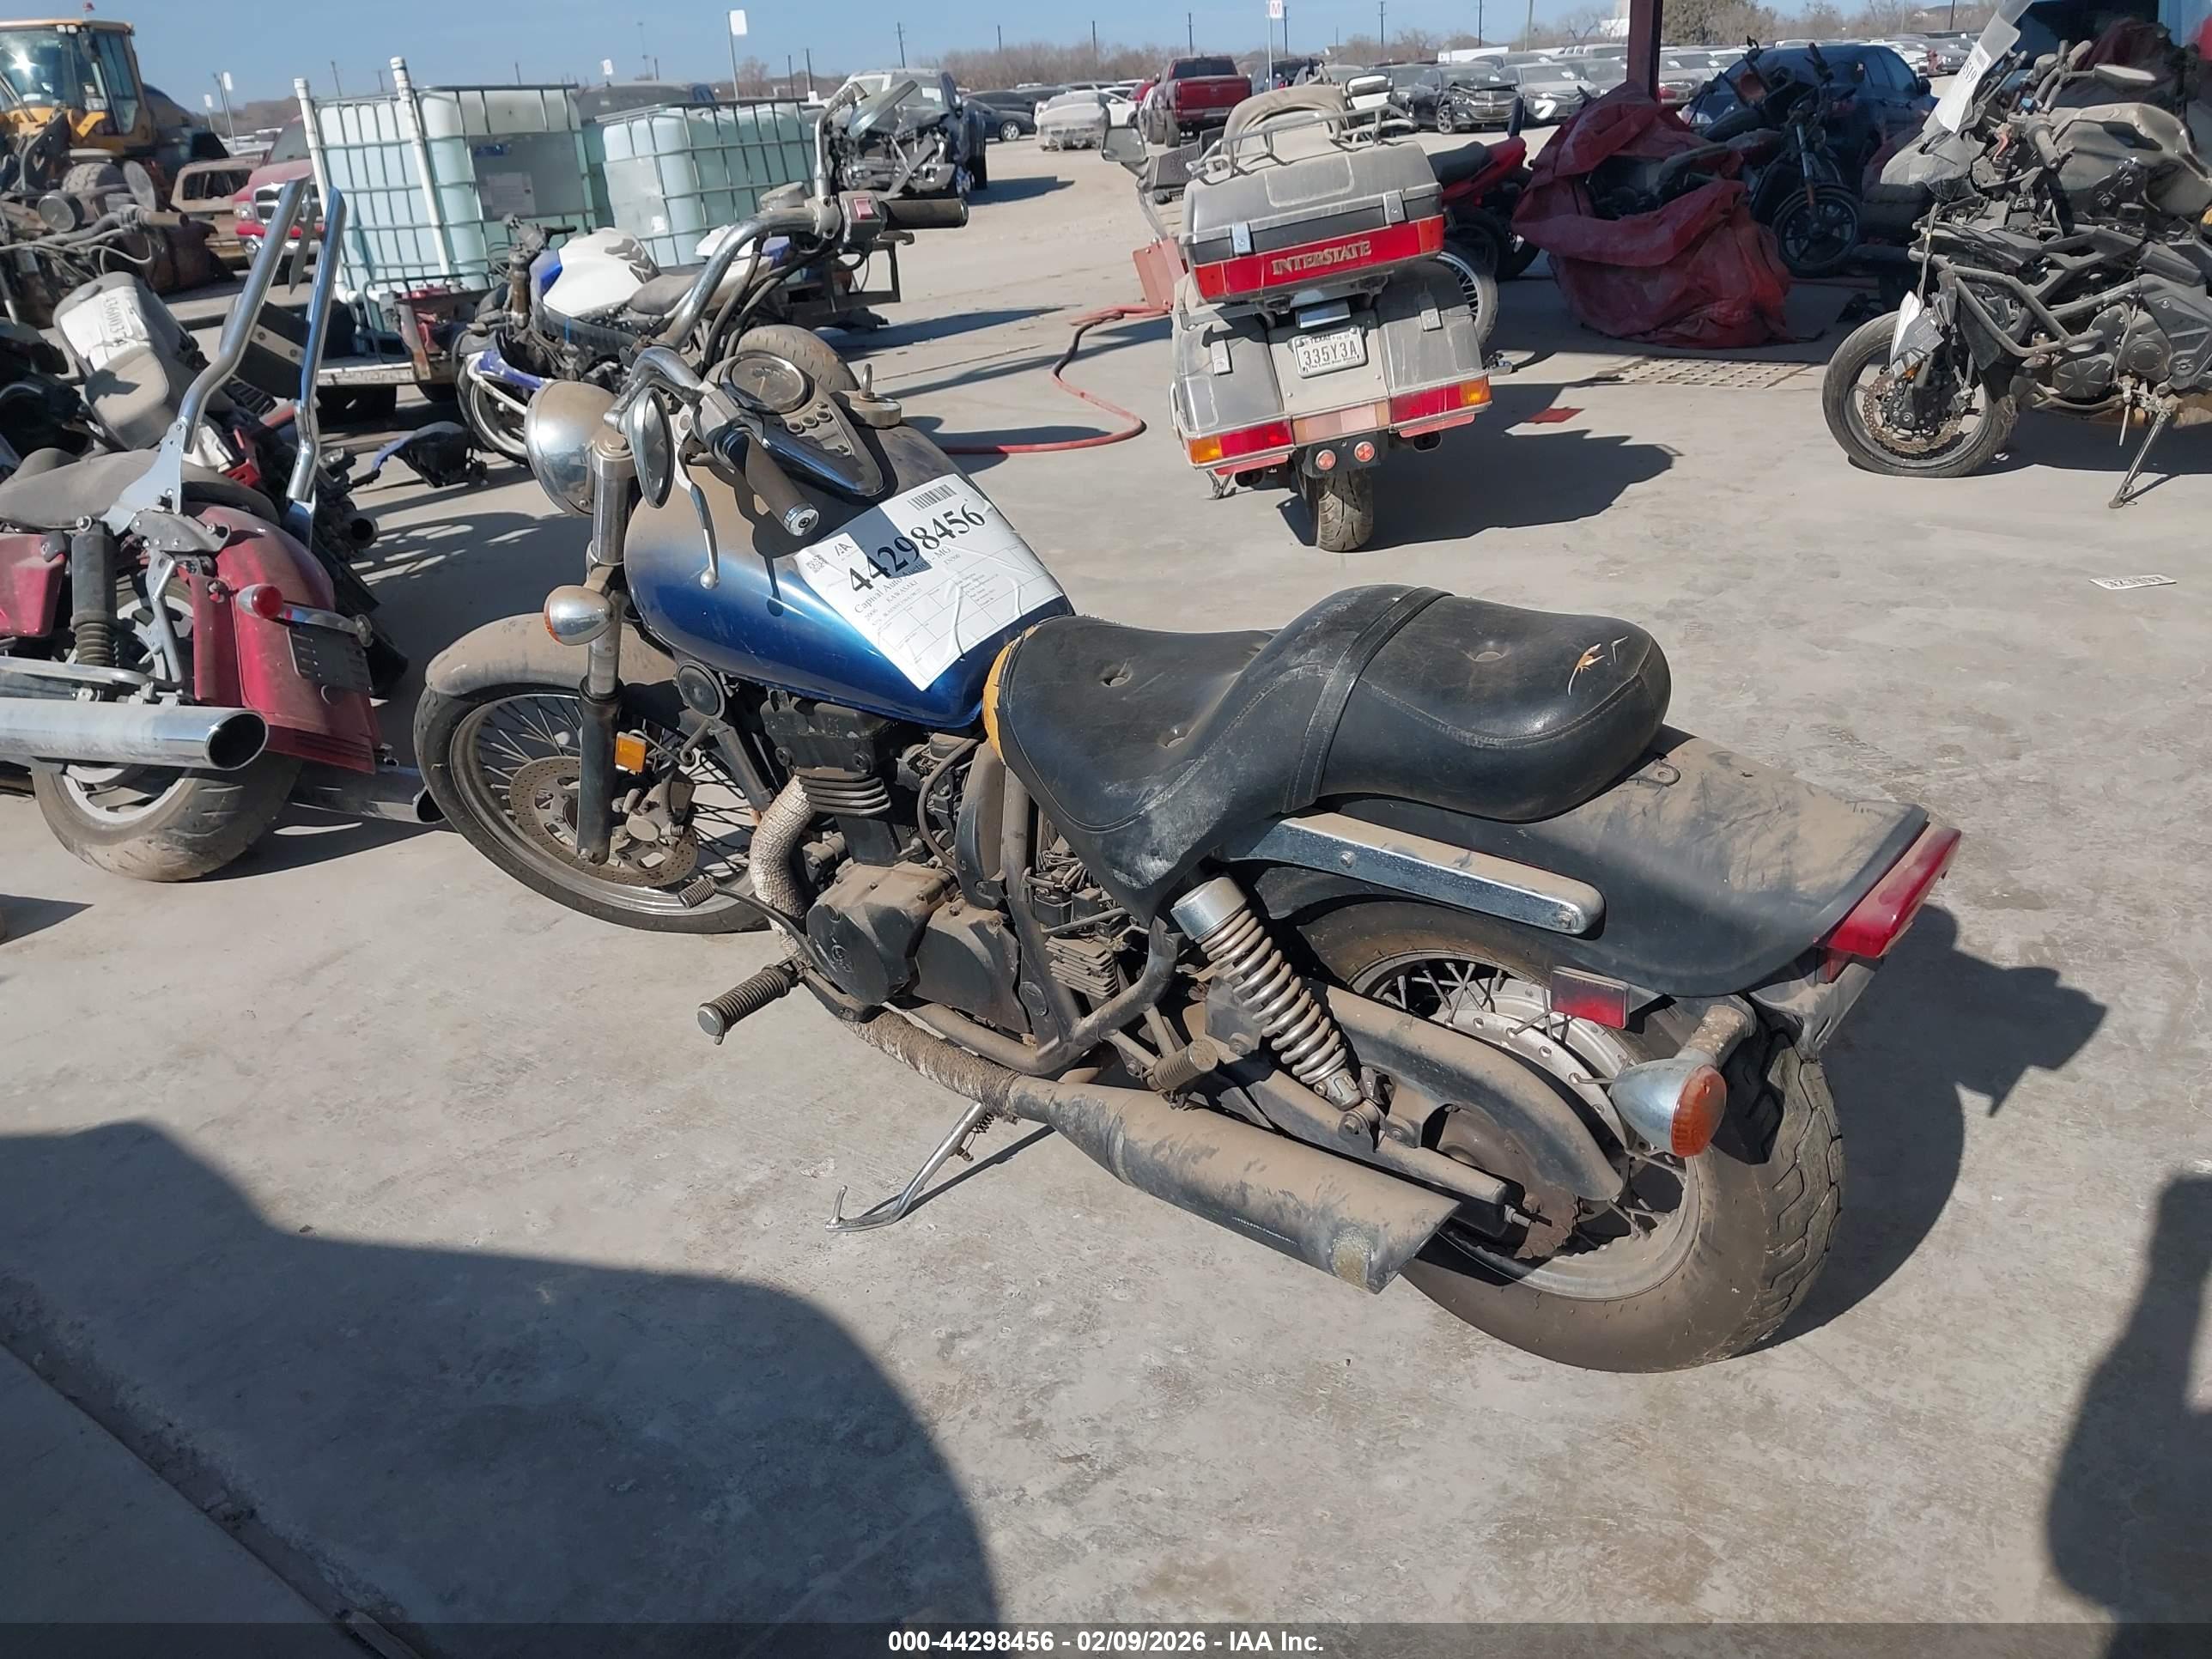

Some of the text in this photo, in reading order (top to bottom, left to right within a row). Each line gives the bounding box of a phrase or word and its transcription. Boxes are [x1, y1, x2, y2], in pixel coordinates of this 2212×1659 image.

[1271, 240, 1372, 276] INTERSTATE
[1303, 340, 1358, 367] 335Y3A
[849, 503, 986, 592] 44298456
